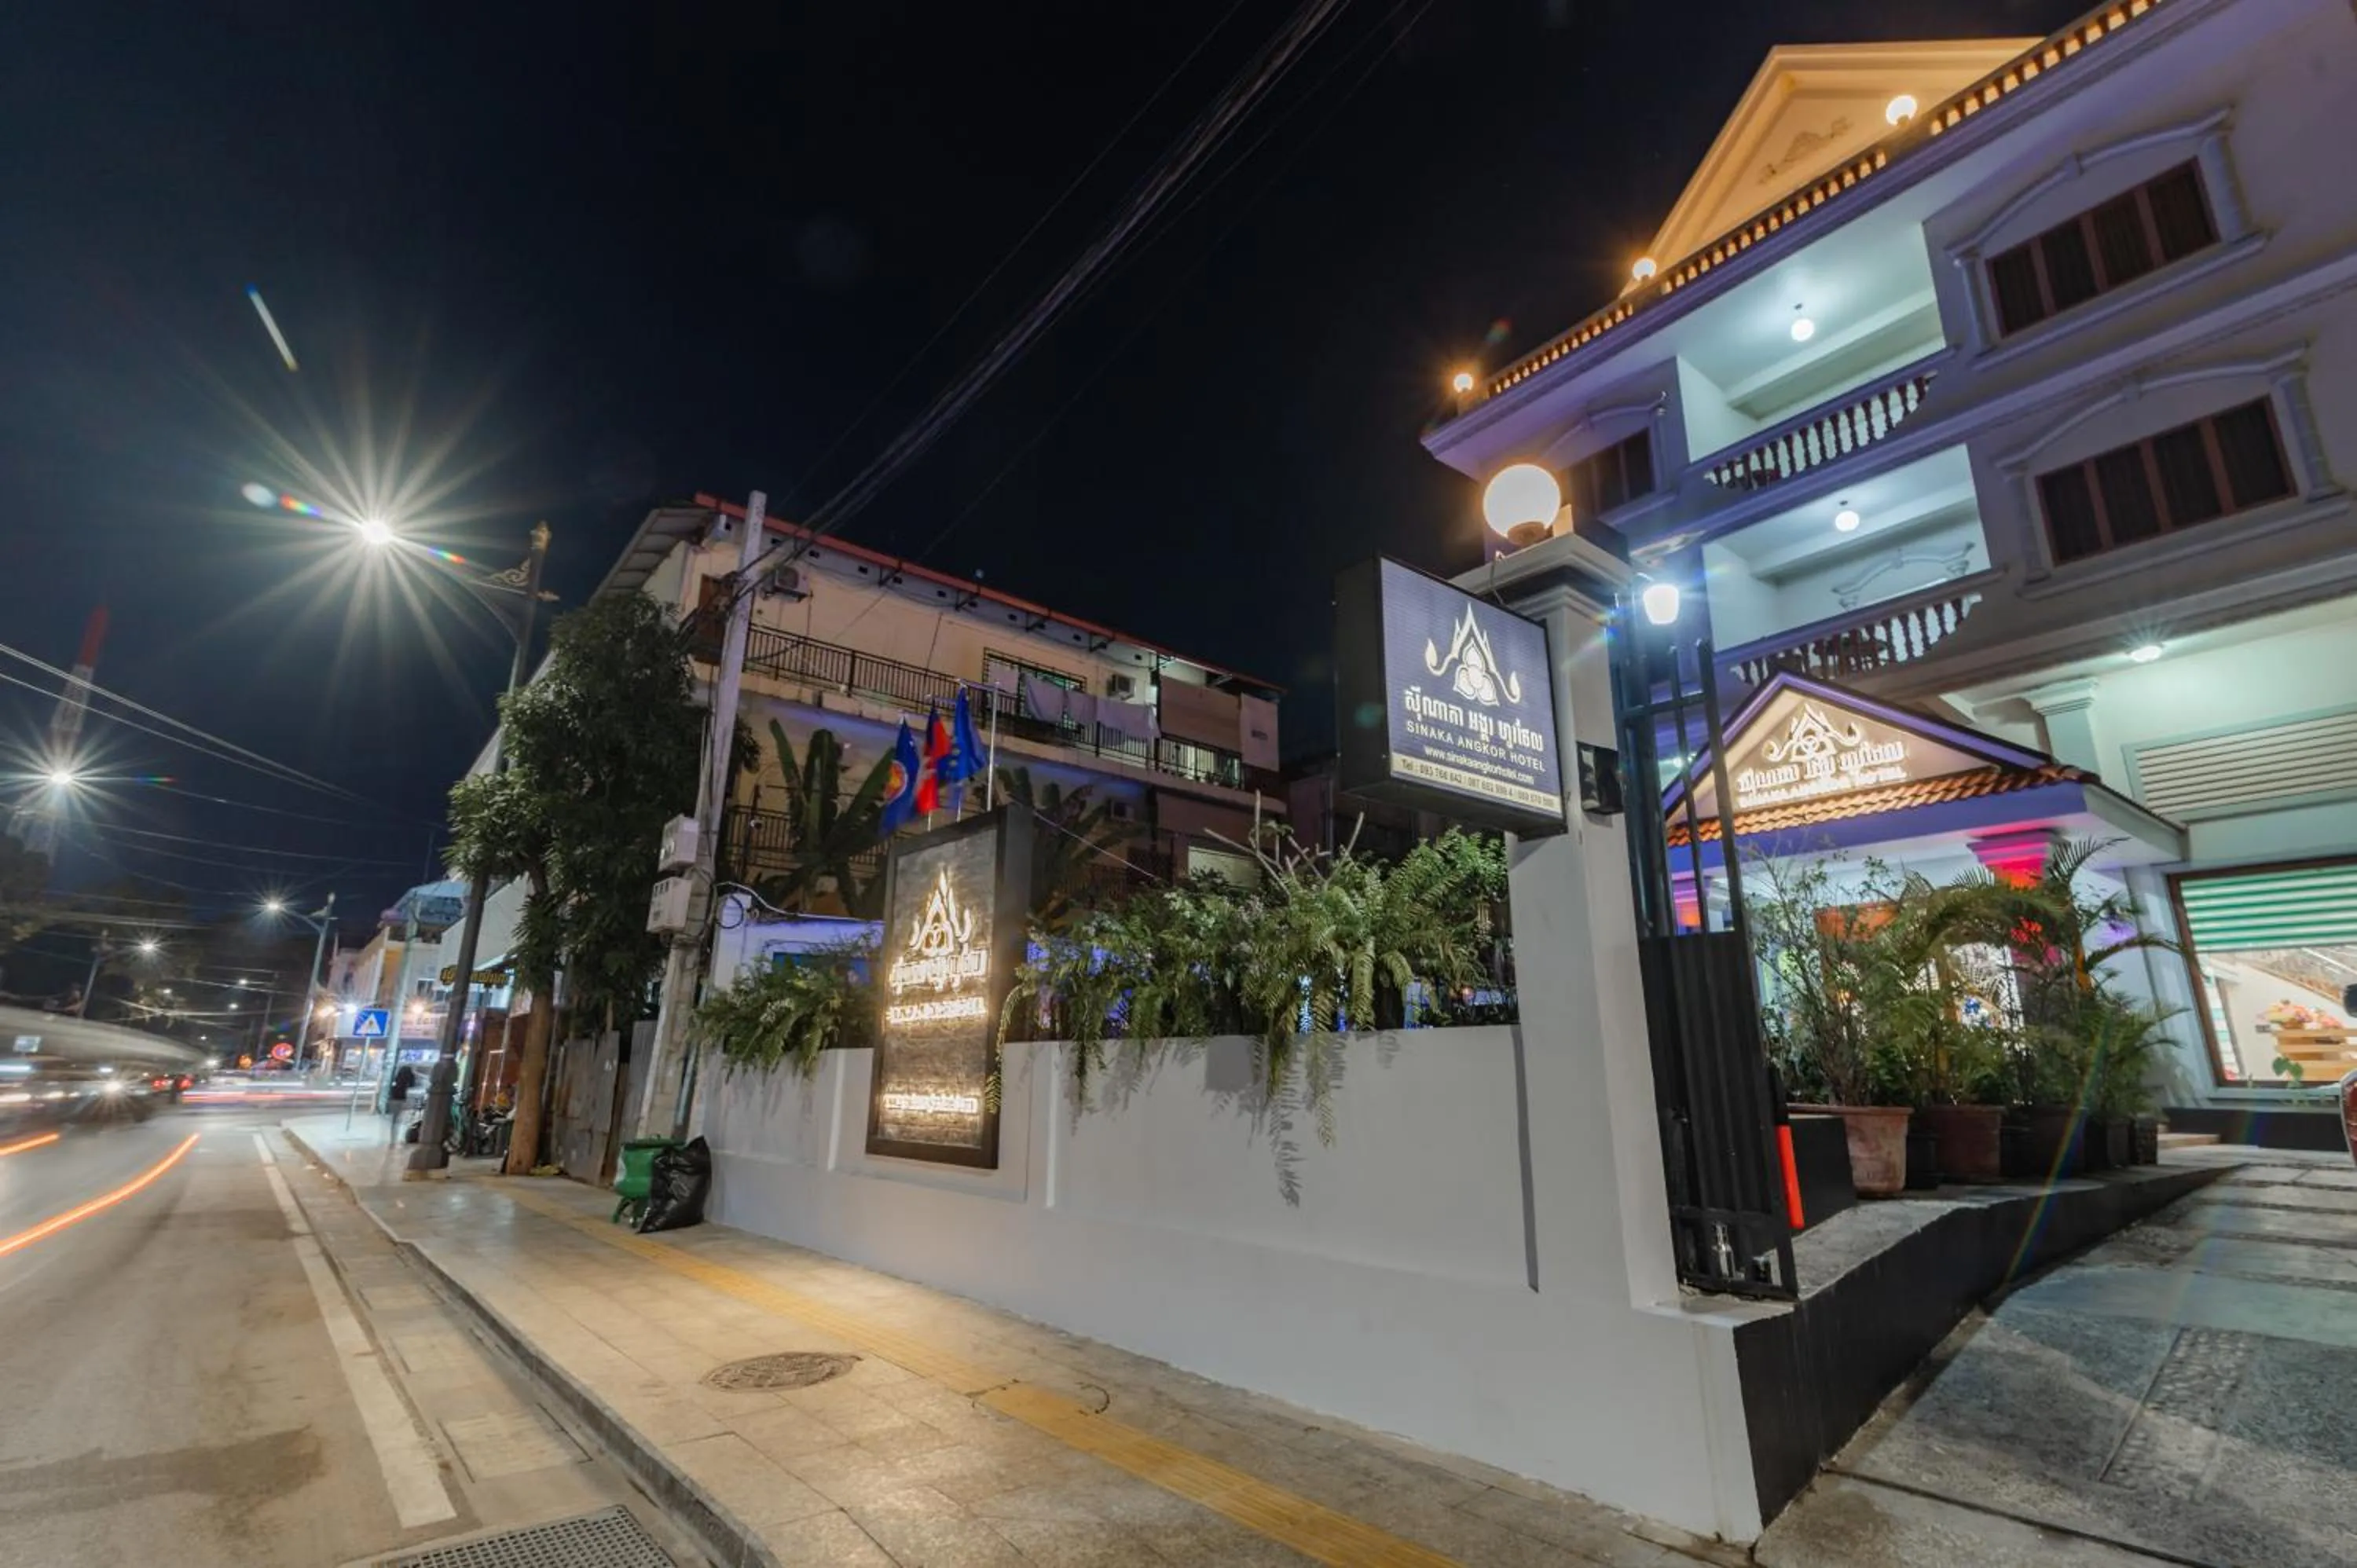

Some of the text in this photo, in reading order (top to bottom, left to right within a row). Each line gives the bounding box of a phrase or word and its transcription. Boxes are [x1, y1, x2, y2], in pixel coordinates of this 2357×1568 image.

[1406, 720, 1546, 773] SINAKA ANGKOR HOTEL
